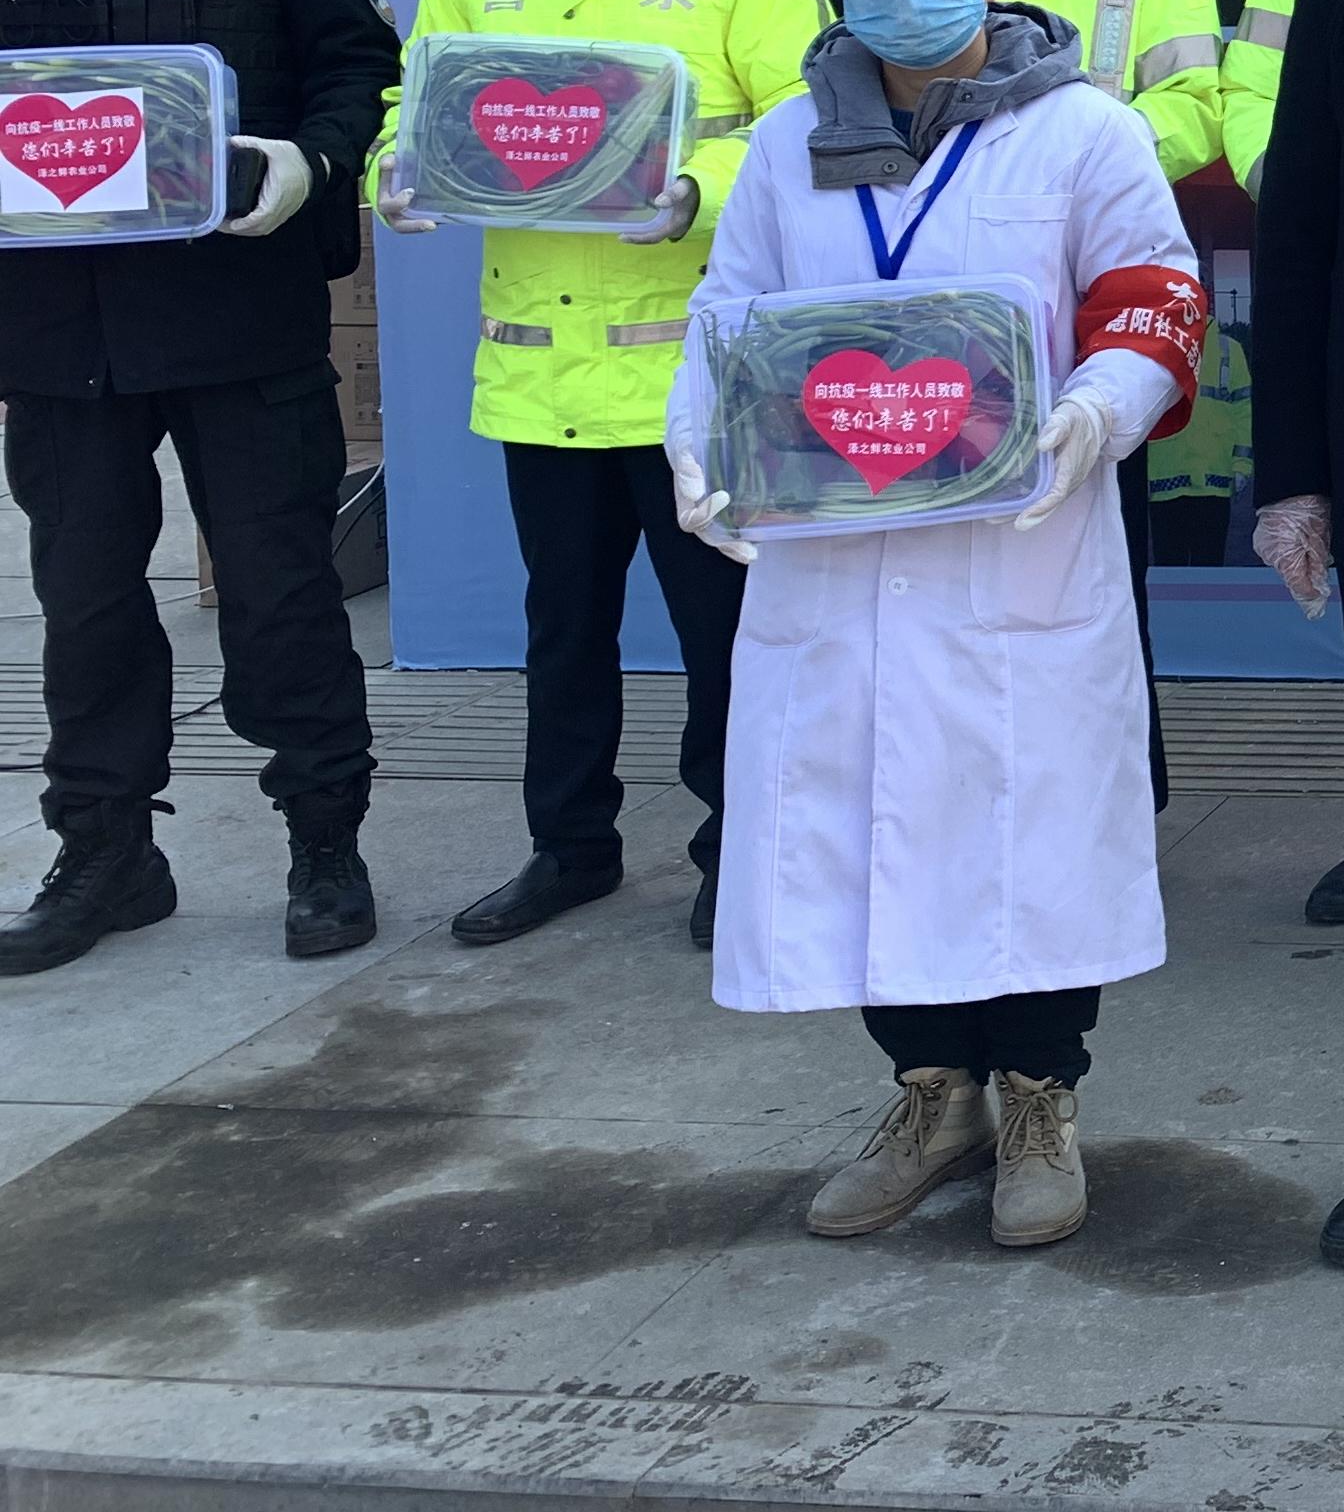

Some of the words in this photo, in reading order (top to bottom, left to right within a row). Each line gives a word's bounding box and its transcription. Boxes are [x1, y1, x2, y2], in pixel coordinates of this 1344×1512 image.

[814, 380, 965, 402] 向抗疫一线工作人员致敬
